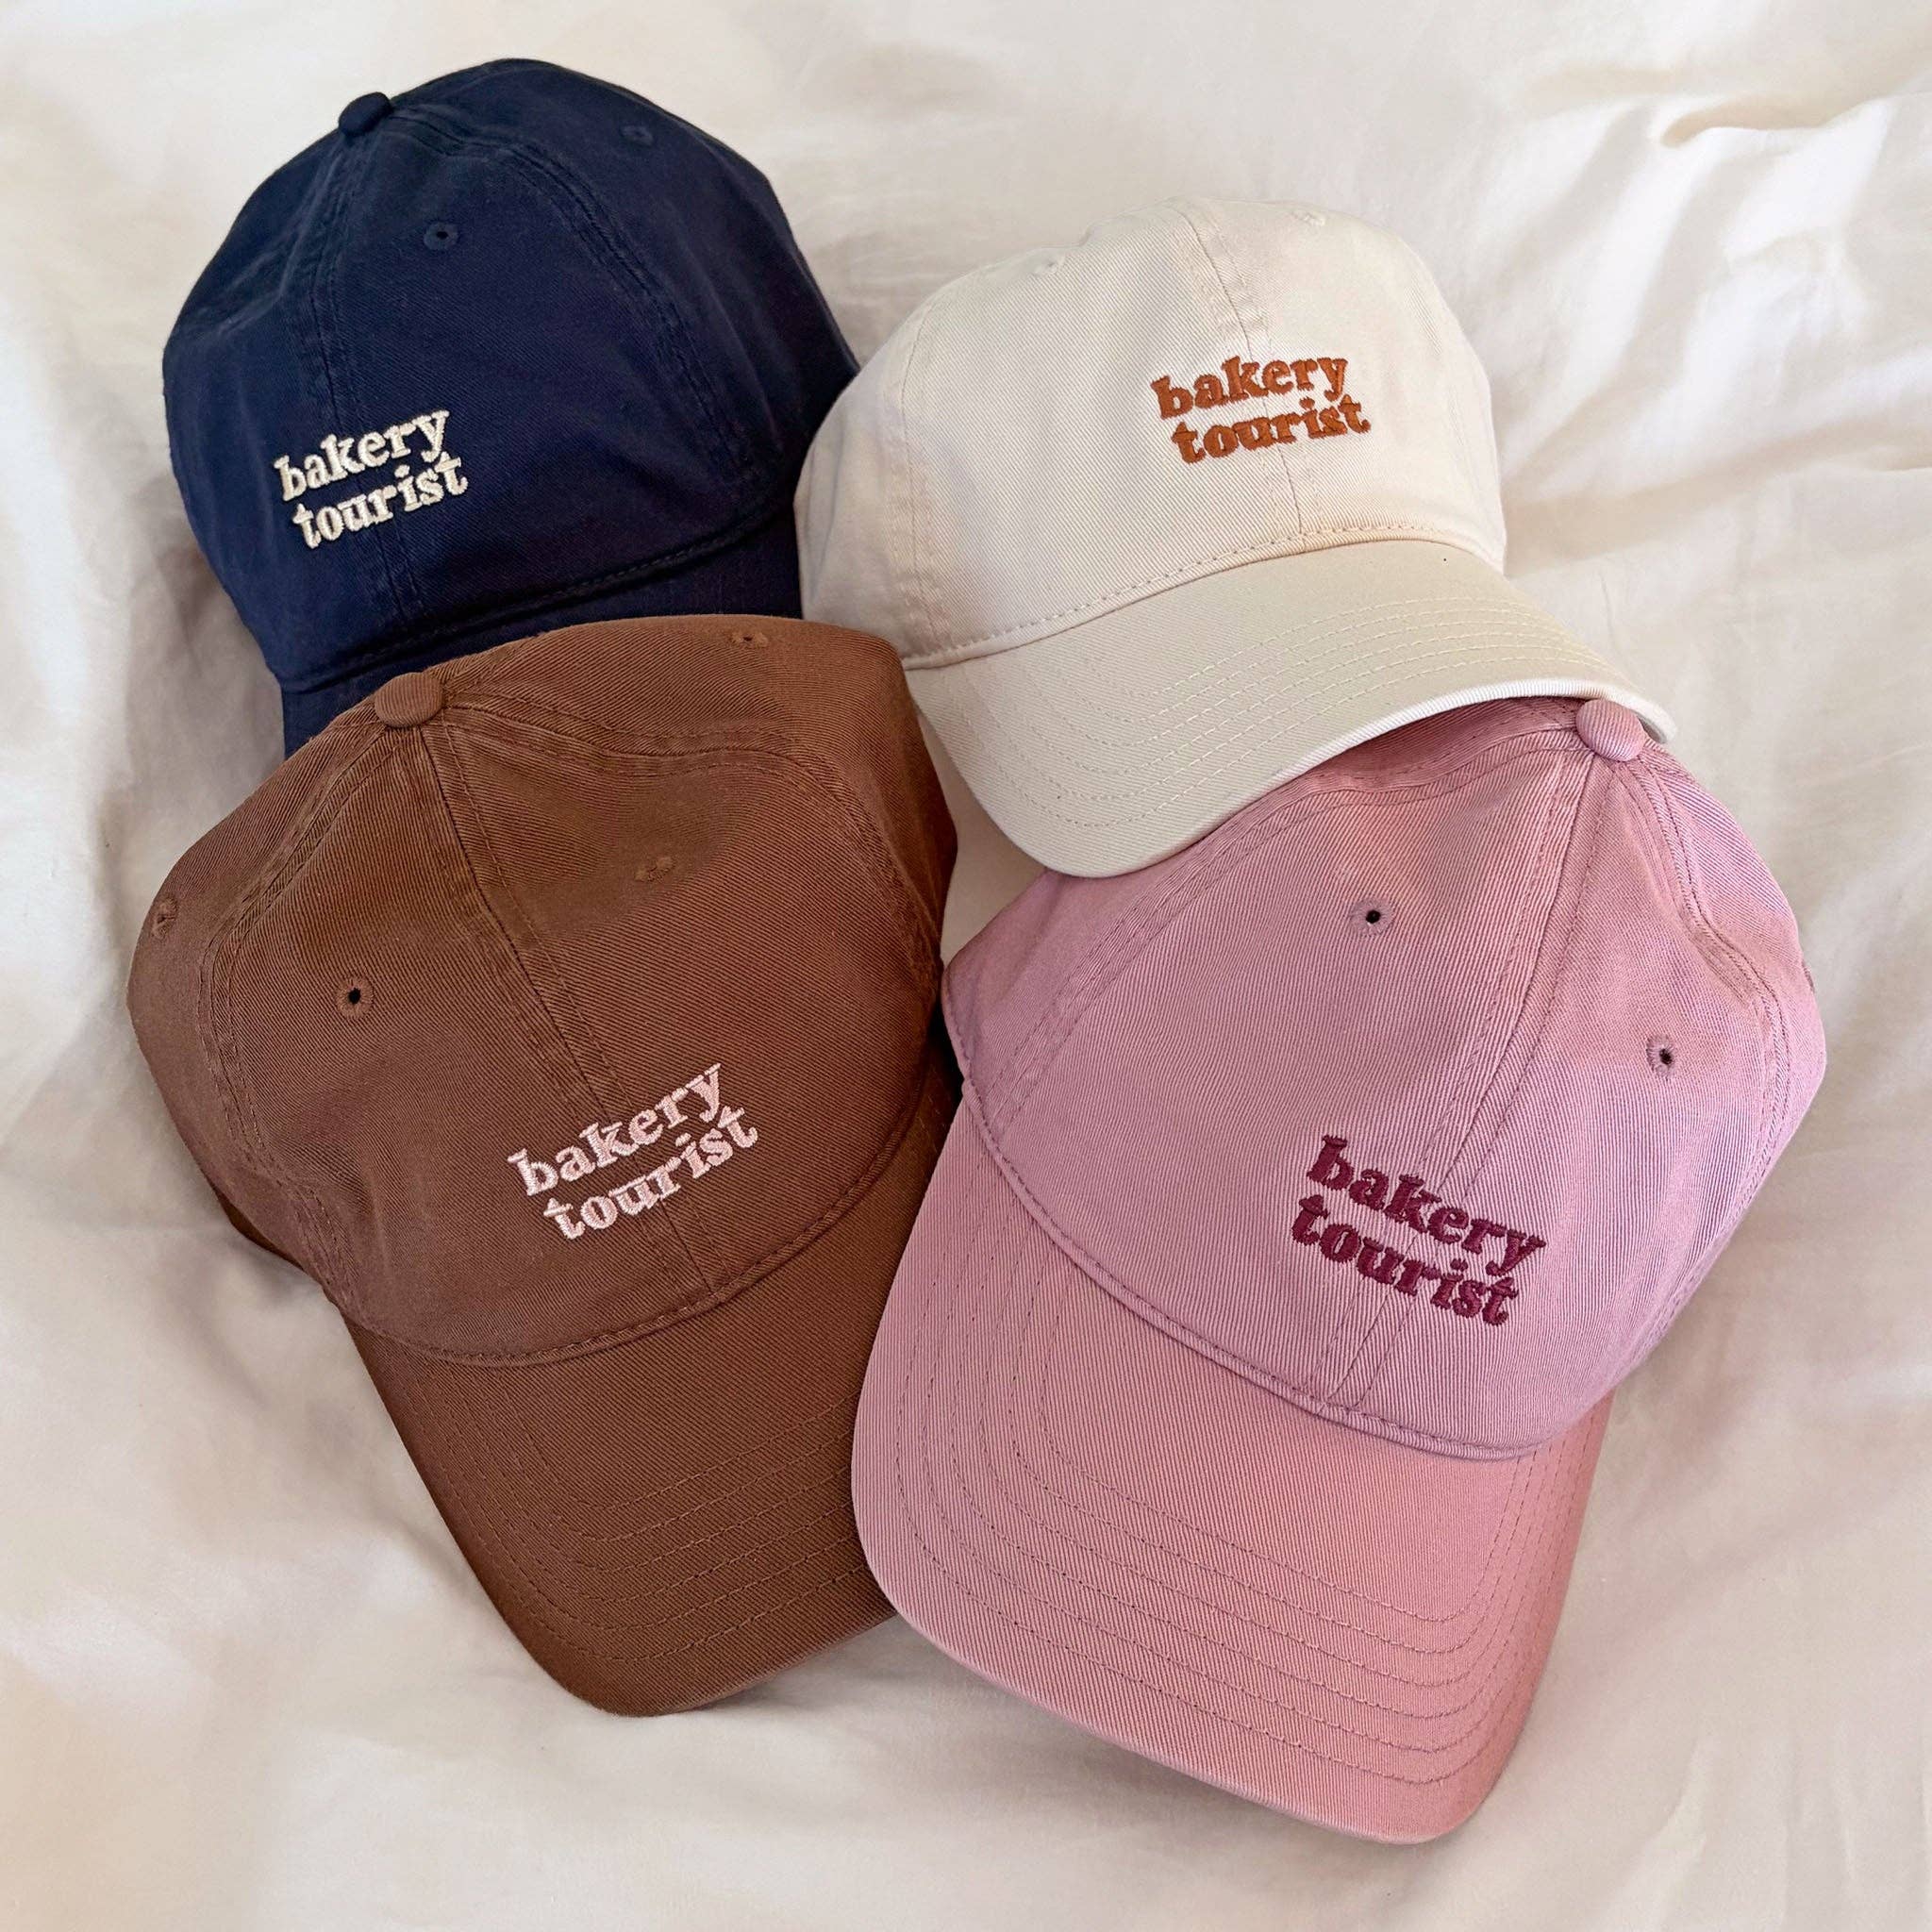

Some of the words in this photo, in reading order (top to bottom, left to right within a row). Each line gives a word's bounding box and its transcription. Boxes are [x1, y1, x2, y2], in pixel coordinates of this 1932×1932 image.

[1150, 356, 1348, 420] bakery
[1171, 393, 1372, 464] tourist
[274, 409, 450, 502] bakery
[292, 451, 469, 549] tourist
[507, 1062, 722, 1196] bakery
[543, 1106, 758, 1240] tourist
[1291, 1194, 1519, 1326] tourist
[1307, 1135, 1546, 1276] bakery
